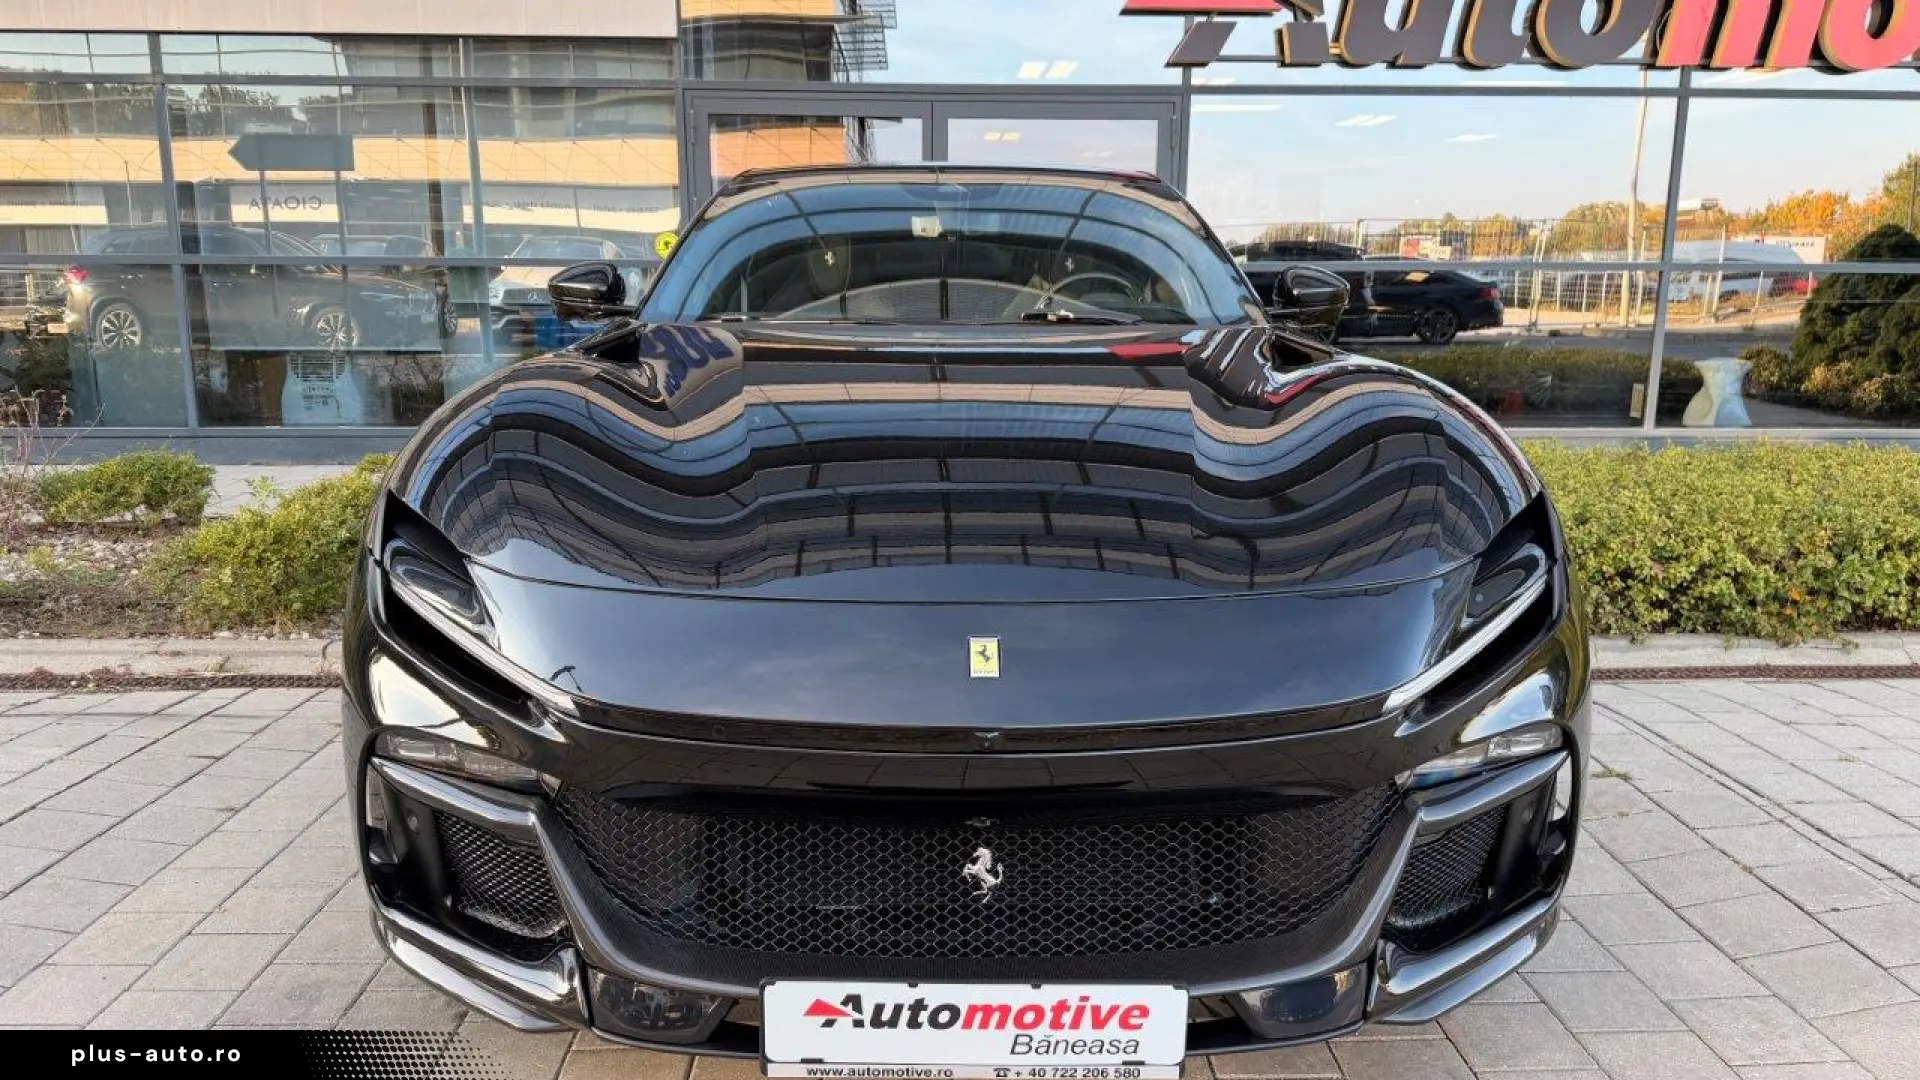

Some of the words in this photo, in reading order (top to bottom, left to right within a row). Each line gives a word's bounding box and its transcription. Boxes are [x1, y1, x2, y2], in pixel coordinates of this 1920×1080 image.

[803, 994, 1150, 1031] Automotive
[1009, 1033, 1141, 1056] Băneasa
[806, 1066, 954, 1078] www.automotive.ro
[1028, 1067, 1047, 1078] 40
[1051, 1067, 1078, 1078] 722
[1082, 1067, 1110, 1078] 206
[1113, 1067, 1141, 1079] 580
